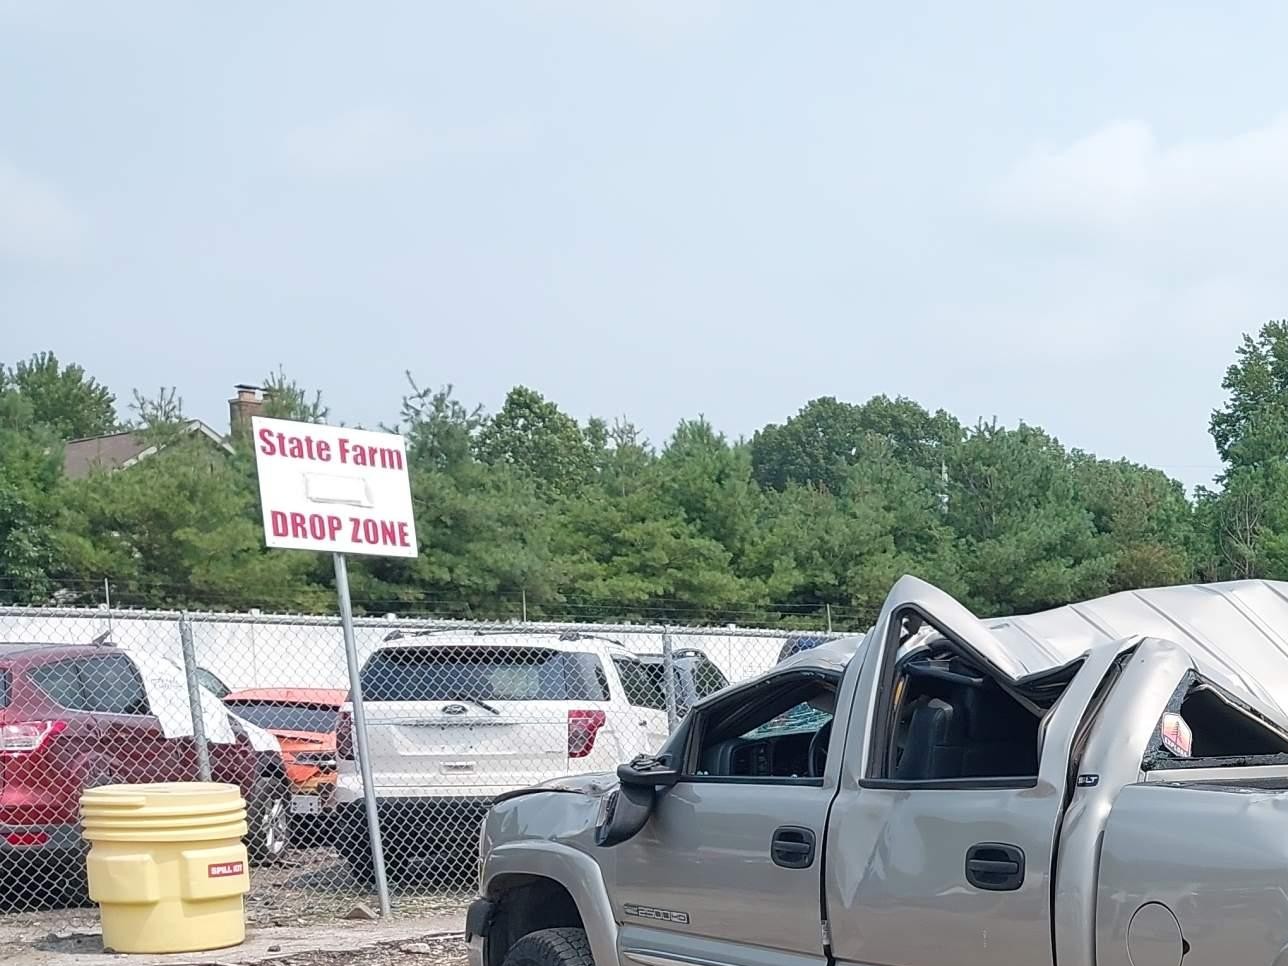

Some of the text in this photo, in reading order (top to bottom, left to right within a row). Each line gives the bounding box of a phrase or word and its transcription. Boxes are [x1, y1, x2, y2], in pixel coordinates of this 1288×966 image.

[259, 428, 404, 471] State Farm
[271, 510, 411, 547] DROP ZONE
